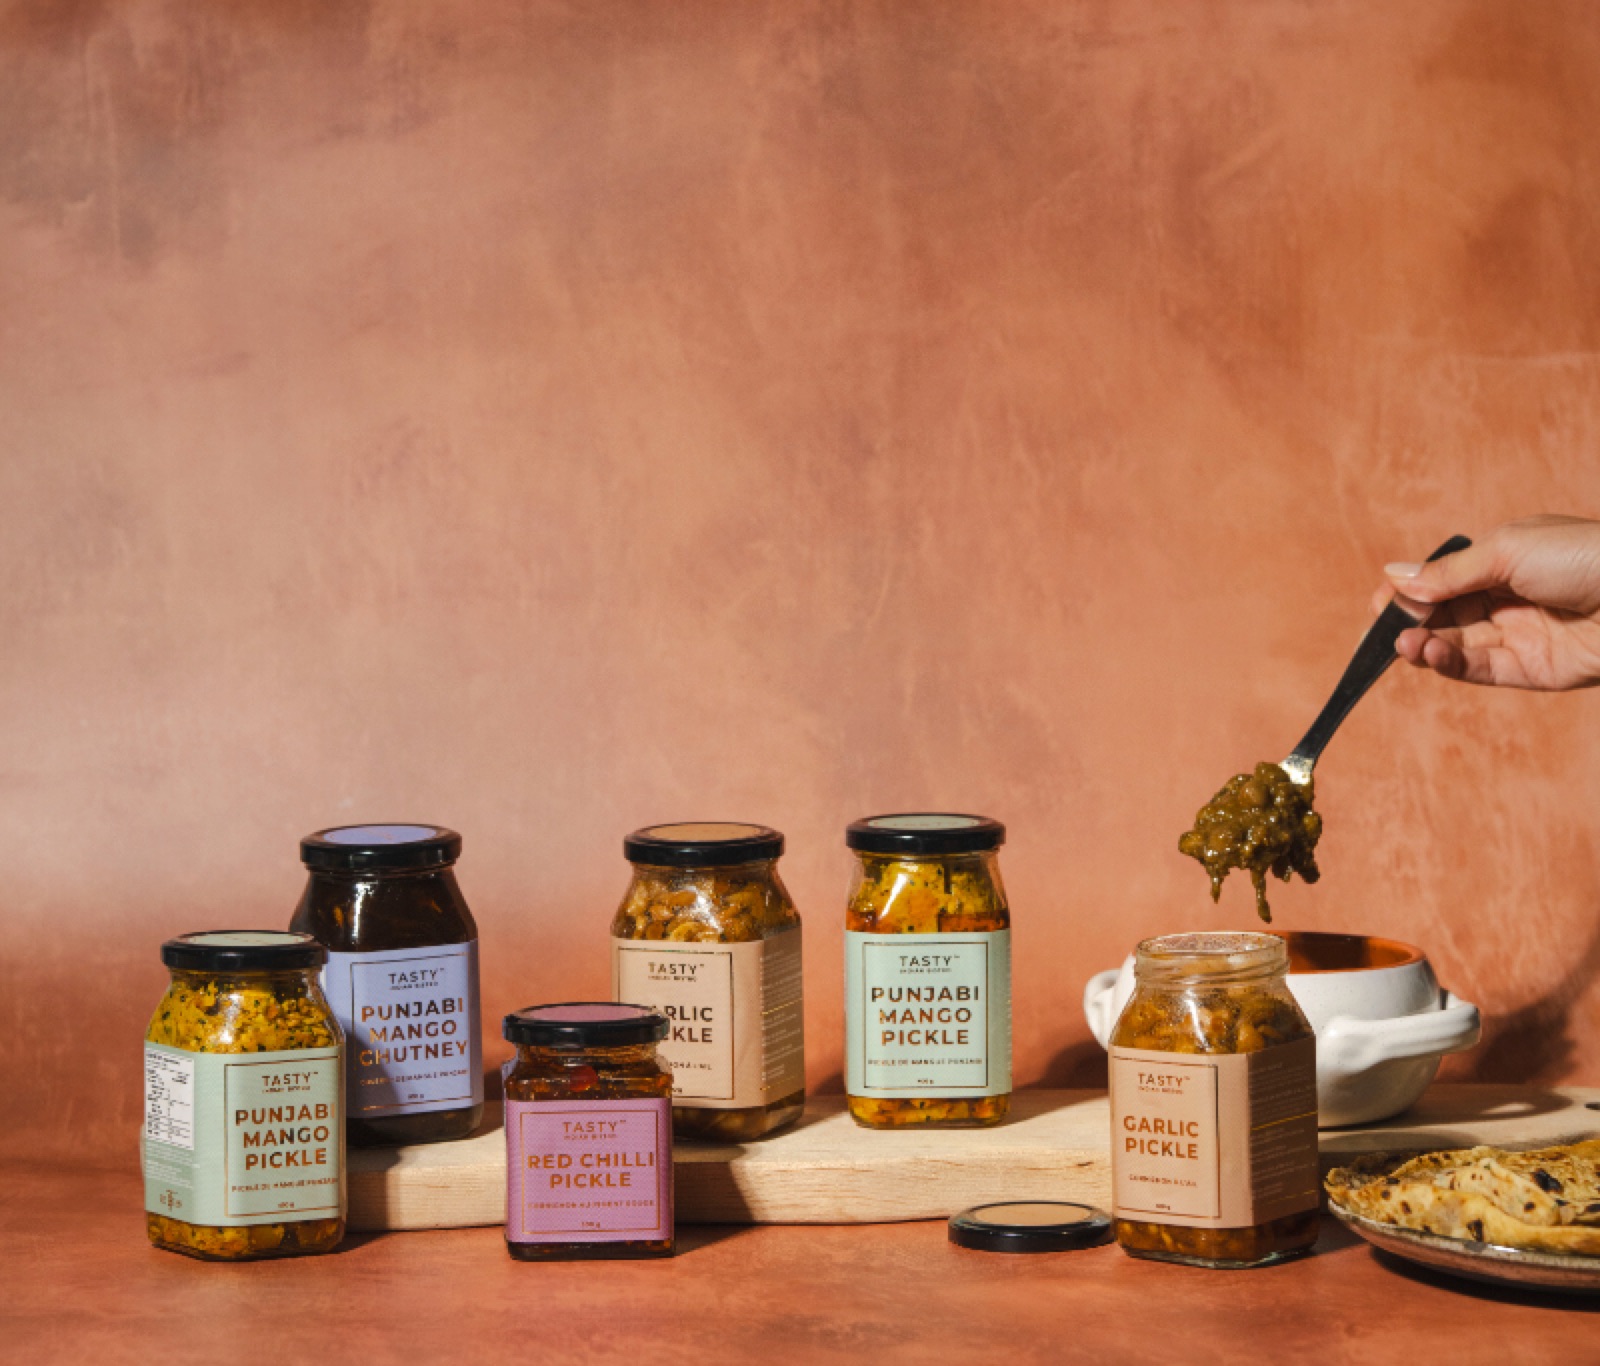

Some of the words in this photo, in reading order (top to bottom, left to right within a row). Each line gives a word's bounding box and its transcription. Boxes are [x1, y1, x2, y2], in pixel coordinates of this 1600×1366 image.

[871, 986, 979, 1003] PUNJABI
[361, 997, 464, 1023] PUNJABI
[653, 1005, 713, 1023] RLIC
[879, 1008, 972, 1025] MANGO
[369, 1019, 457, 1045] MANGO
[881, 1029, 969, 1046] PICKLE
[359, 1040, 467, 1067] CHUTNEY
[235, 1103, 336, 1126] PUNJABI
[243, 1125, 330, 1149] MANGO
[1123, 1115, 1199, 1138] GARLIC
[245, 1147, 327, 1171] PICKLE
[527, 1153, 573, 1169] RED
[579, 1151, 655, 1169] CHILLI
[1125, 1137, 1199, 1160] PICKLE
[549, 1171, 633, 1189] PICKLE
